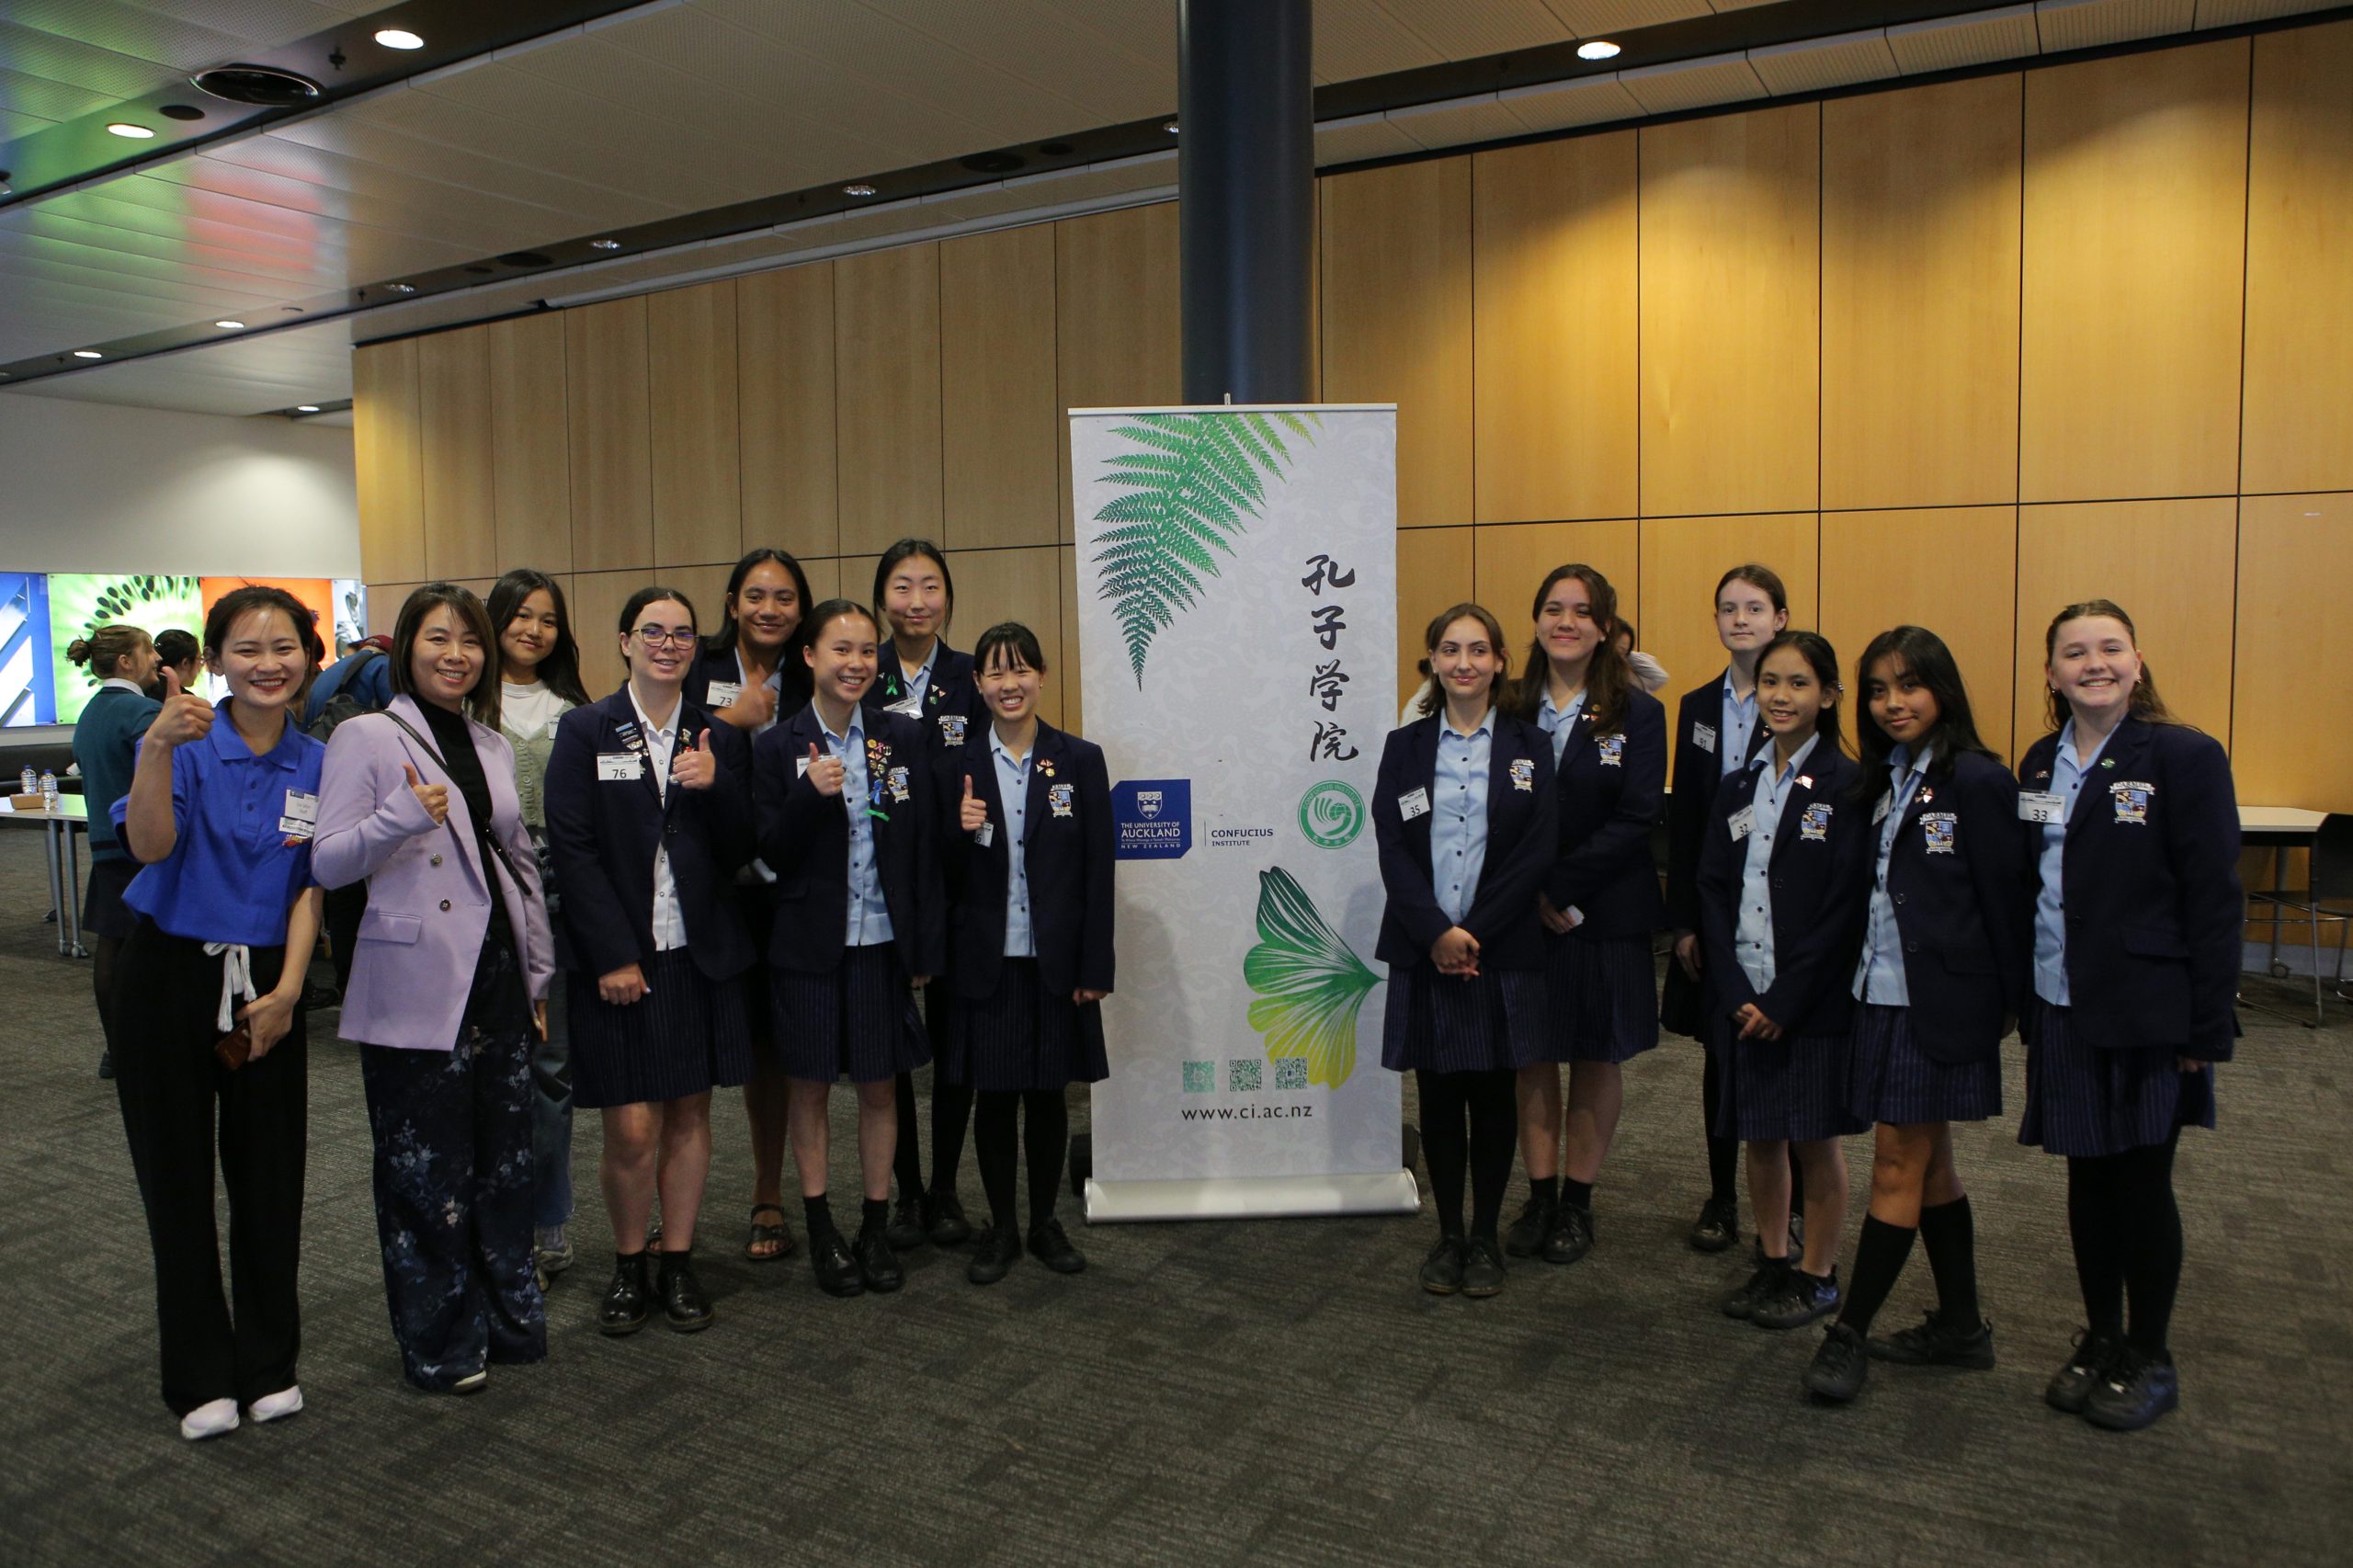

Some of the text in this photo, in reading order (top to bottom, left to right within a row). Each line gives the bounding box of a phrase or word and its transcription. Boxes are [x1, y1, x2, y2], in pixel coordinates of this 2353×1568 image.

[1302, 554, 1358, 762] 孔子学院
[720, 696, 733, 707] 73
[611, 768, 627, 778] 76
[1410, 804, 1420, 817] 35
[2032, 809, 2048, 822] 33
[1121, 828, 1180, 838] AUCKLAND
[1211, 828, 1274, 838] CONFUCIUS
[1181, 1103, 1313, 1120] www.ci.ac.nz
